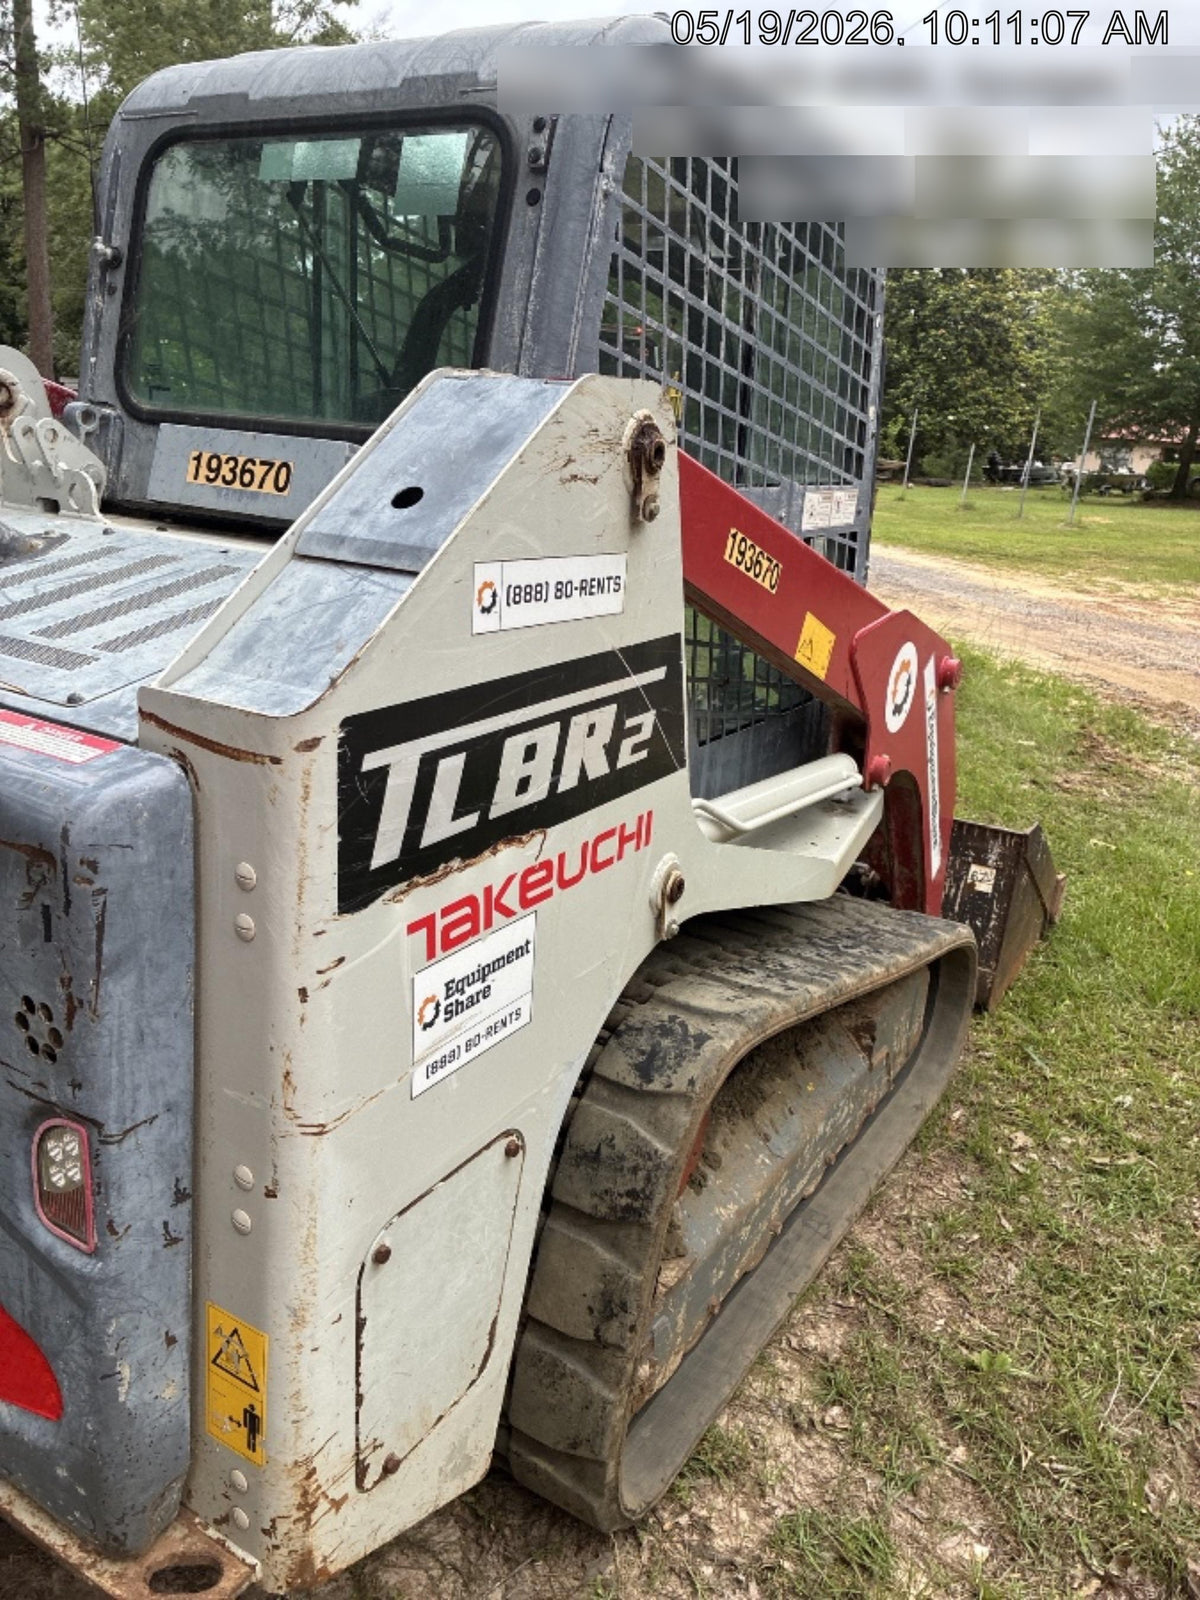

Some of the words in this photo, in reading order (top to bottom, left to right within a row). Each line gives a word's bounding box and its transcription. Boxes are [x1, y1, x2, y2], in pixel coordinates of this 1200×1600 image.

[191, 450, 293, 494] 193670
[728, 530, 780, 591] 193670
[505, 580, 550, 607] (888)
[554, 575, 622, 600] 80-RENTS
[443, 938, 532, 1001] Equipment
[443, 984, 492, 1023] Share
[425, 1044, 461, 1080] (888)
[464, 1007, 523, 1054] 80-RENTS
